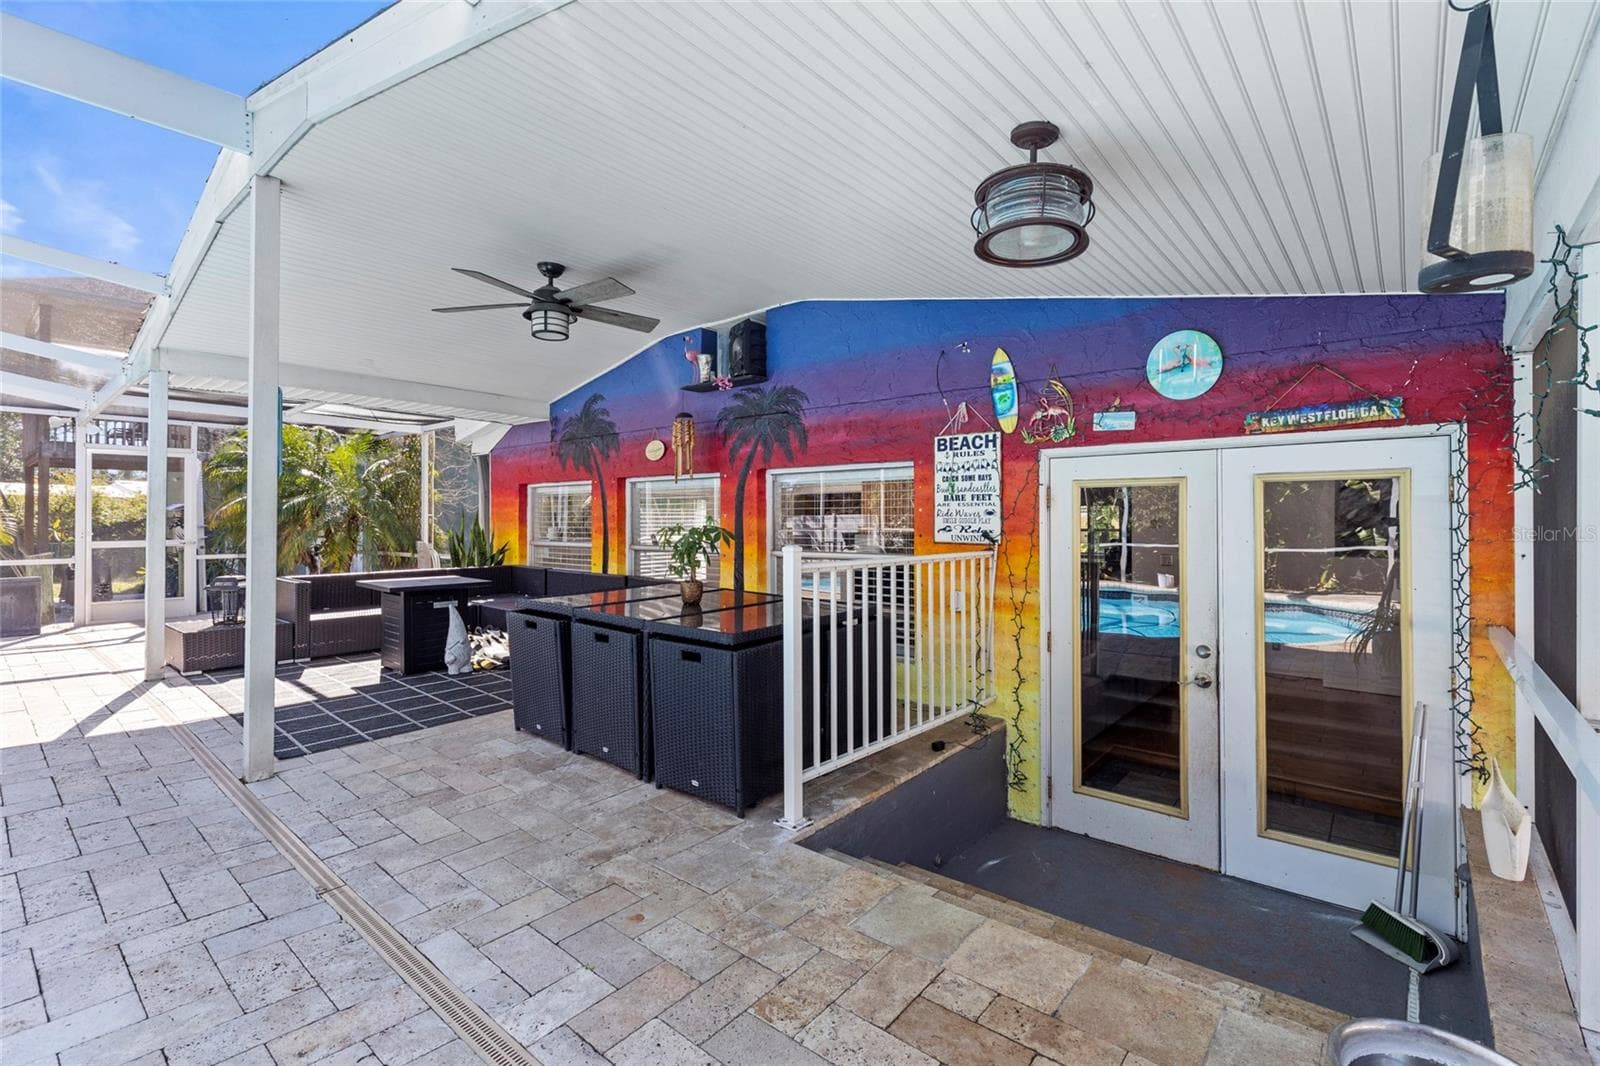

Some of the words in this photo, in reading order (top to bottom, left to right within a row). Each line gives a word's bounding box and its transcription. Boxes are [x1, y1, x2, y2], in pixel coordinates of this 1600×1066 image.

[1261, 415, 1285, 427] KEY
[1288, 412, 1322, 425] WEST
[937, 434, 996, 451] BEACH
[936, 509, 953, 517] Ride
[956, 509, 981, 518] Waves
